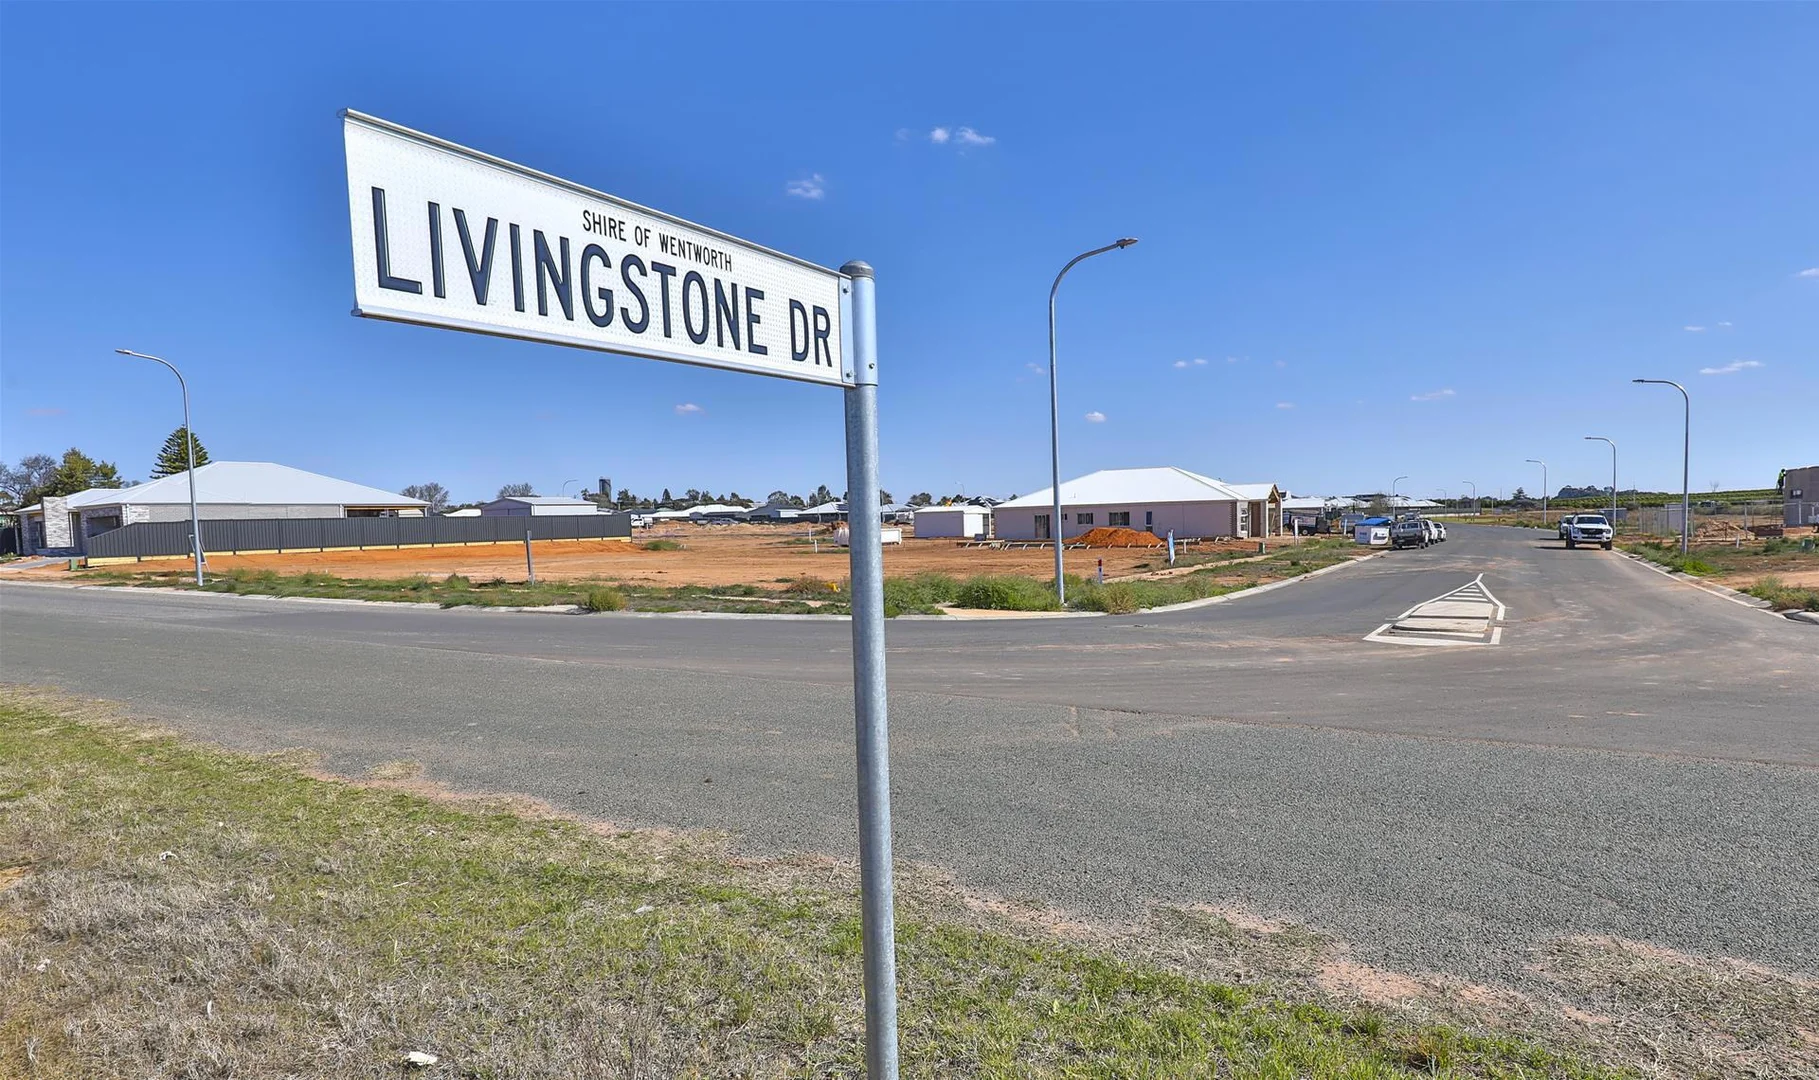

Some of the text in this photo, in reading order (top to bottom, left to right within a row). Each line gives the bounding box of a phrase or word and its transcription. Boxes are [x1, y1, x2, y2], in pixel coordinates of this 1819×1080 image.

[372, 186, 833, 368] LIVINGSTONE DR
[583, 210, 732, 272] SHIRE OF WENTWORTH
